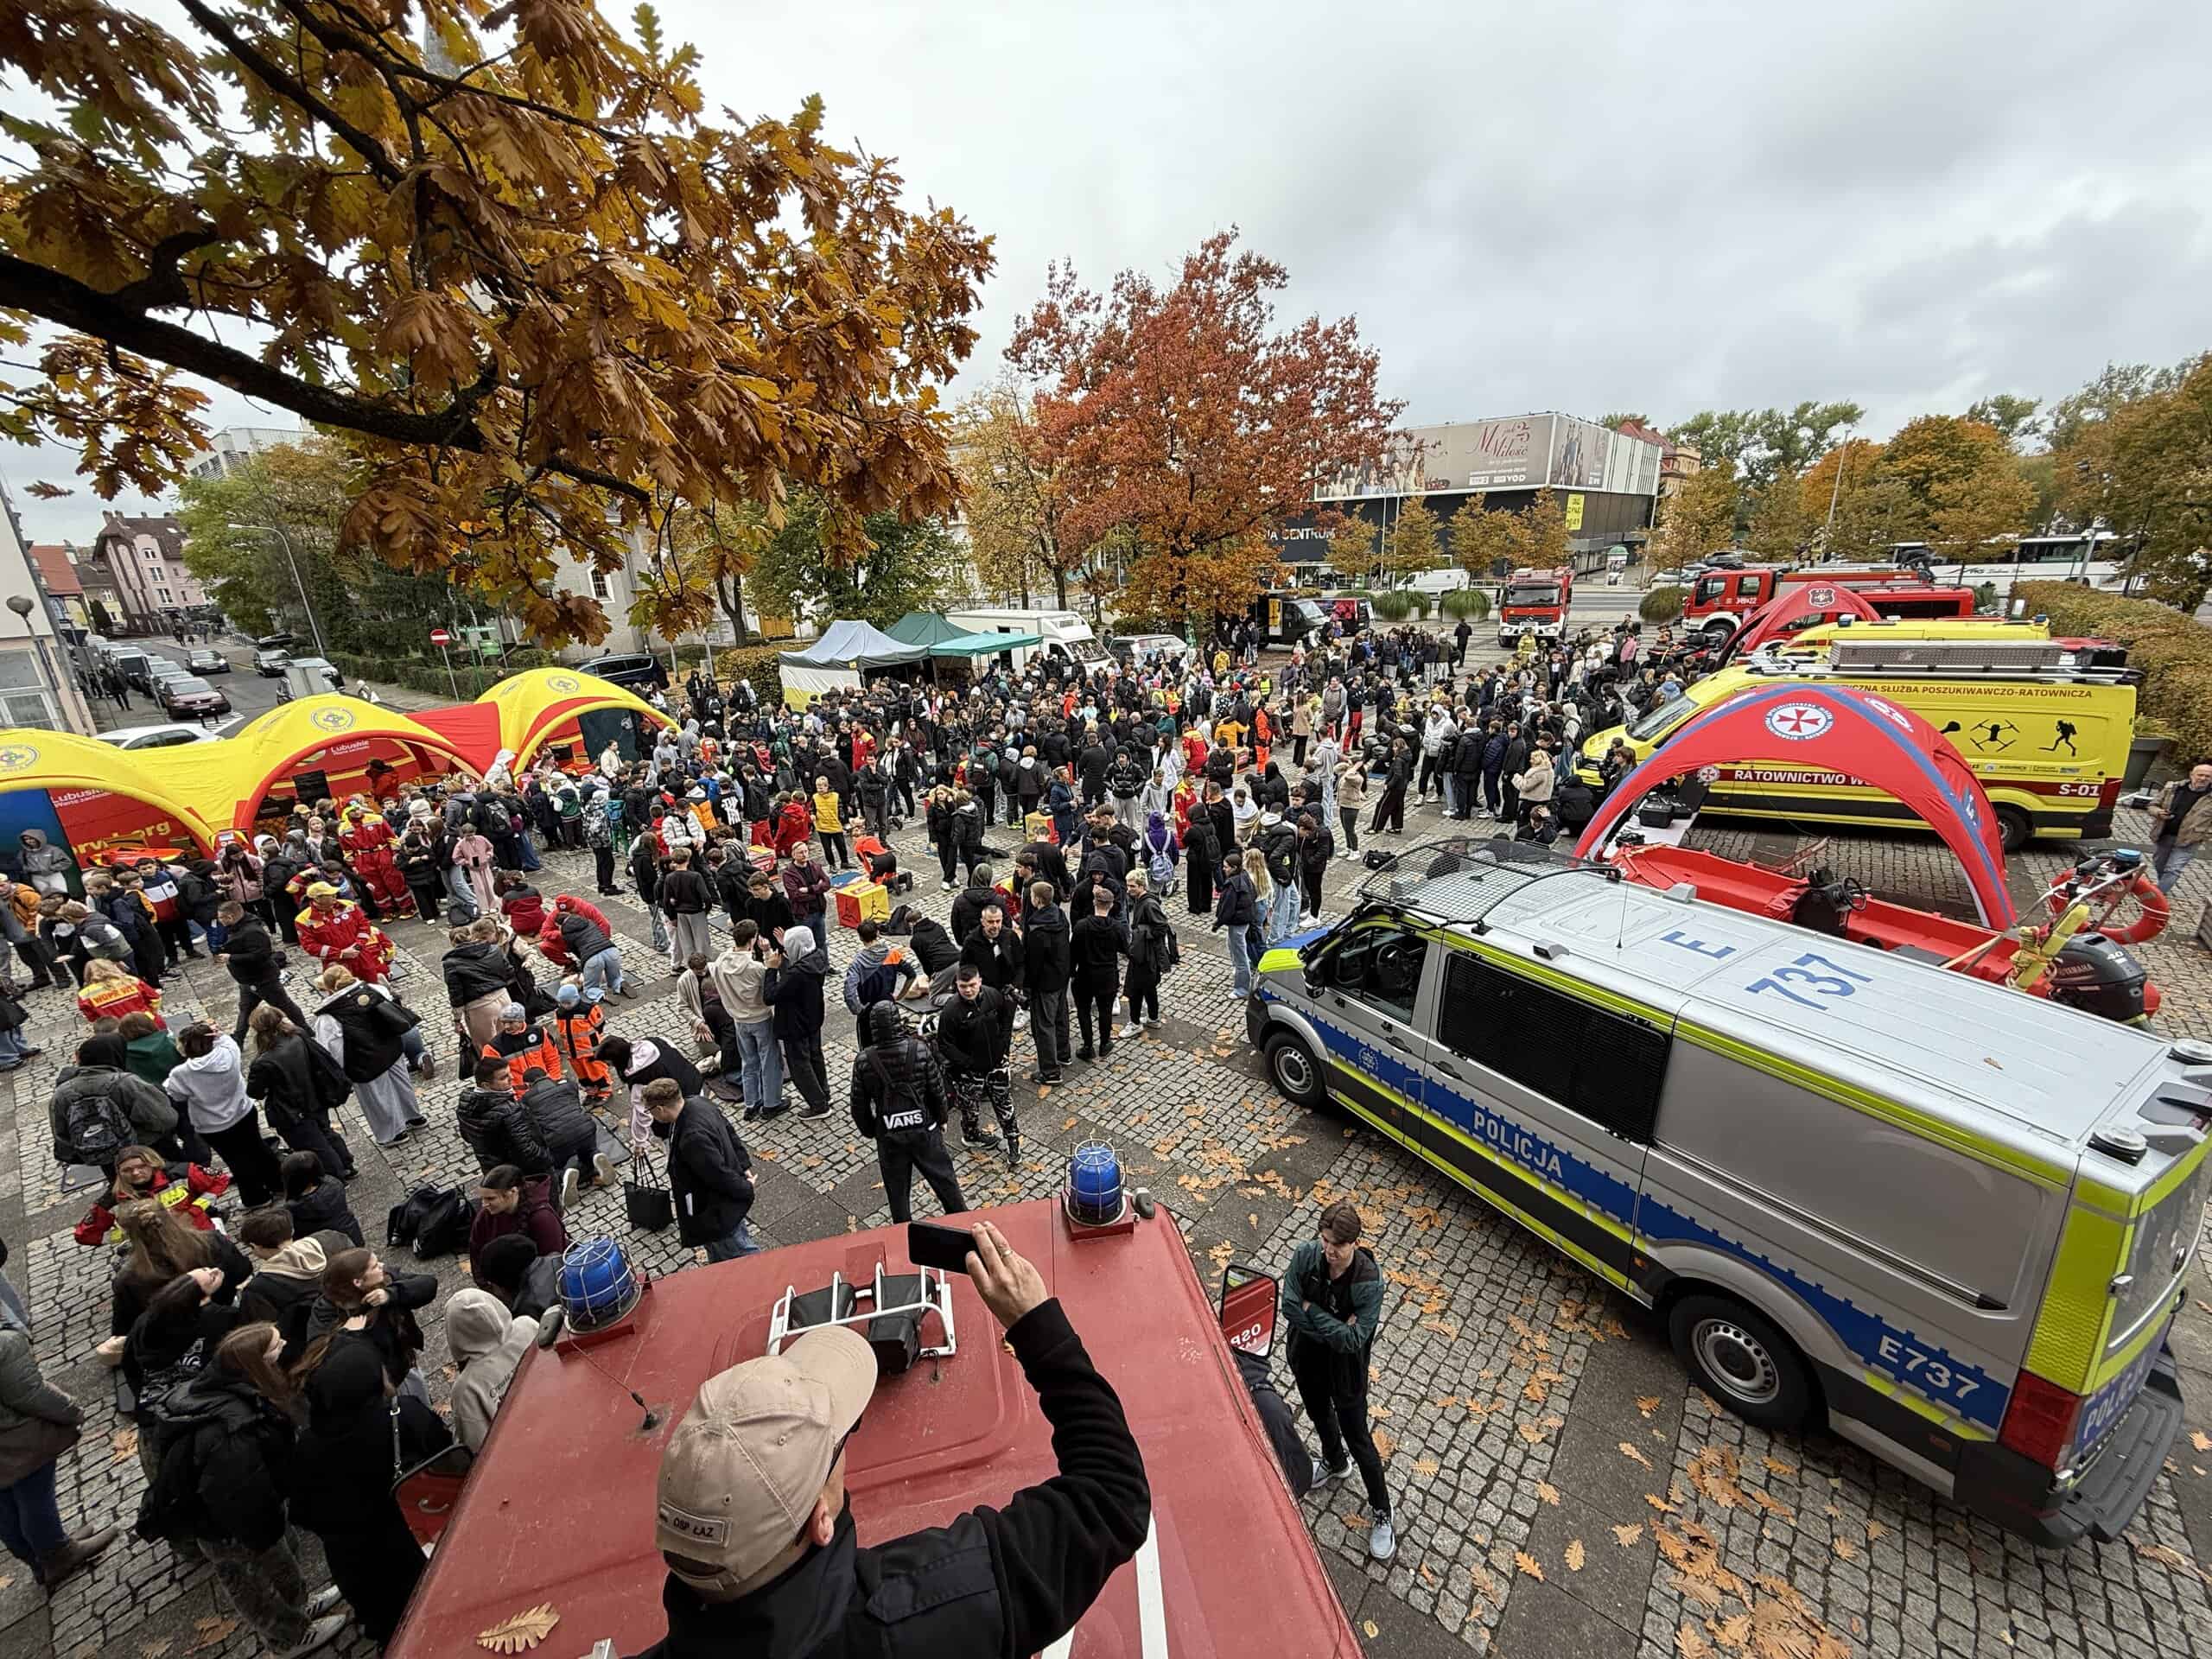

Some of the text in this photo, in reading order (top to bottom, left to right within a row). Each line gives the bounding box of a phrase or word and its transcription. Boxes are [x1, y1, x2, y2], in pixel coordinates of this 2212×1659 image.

[1880, 683, 1919, 694] SŁUŻBA
[1922, 686, 2093, 699] POSZUKIWAWCZO-RATOWNICZA
[1734, 769, 1847, 785] RATOWNICTWO
[2059, 784, 2101, 797] S-01
[1660, 931, 1738, 960] E
[1745, 952, 1873, 1011] 737
[883, 1109, 924, 1129] VANS
[1474, 1110, 1563, 1179] POLICJA
[1878, 1335, 1980, 1399] E737
